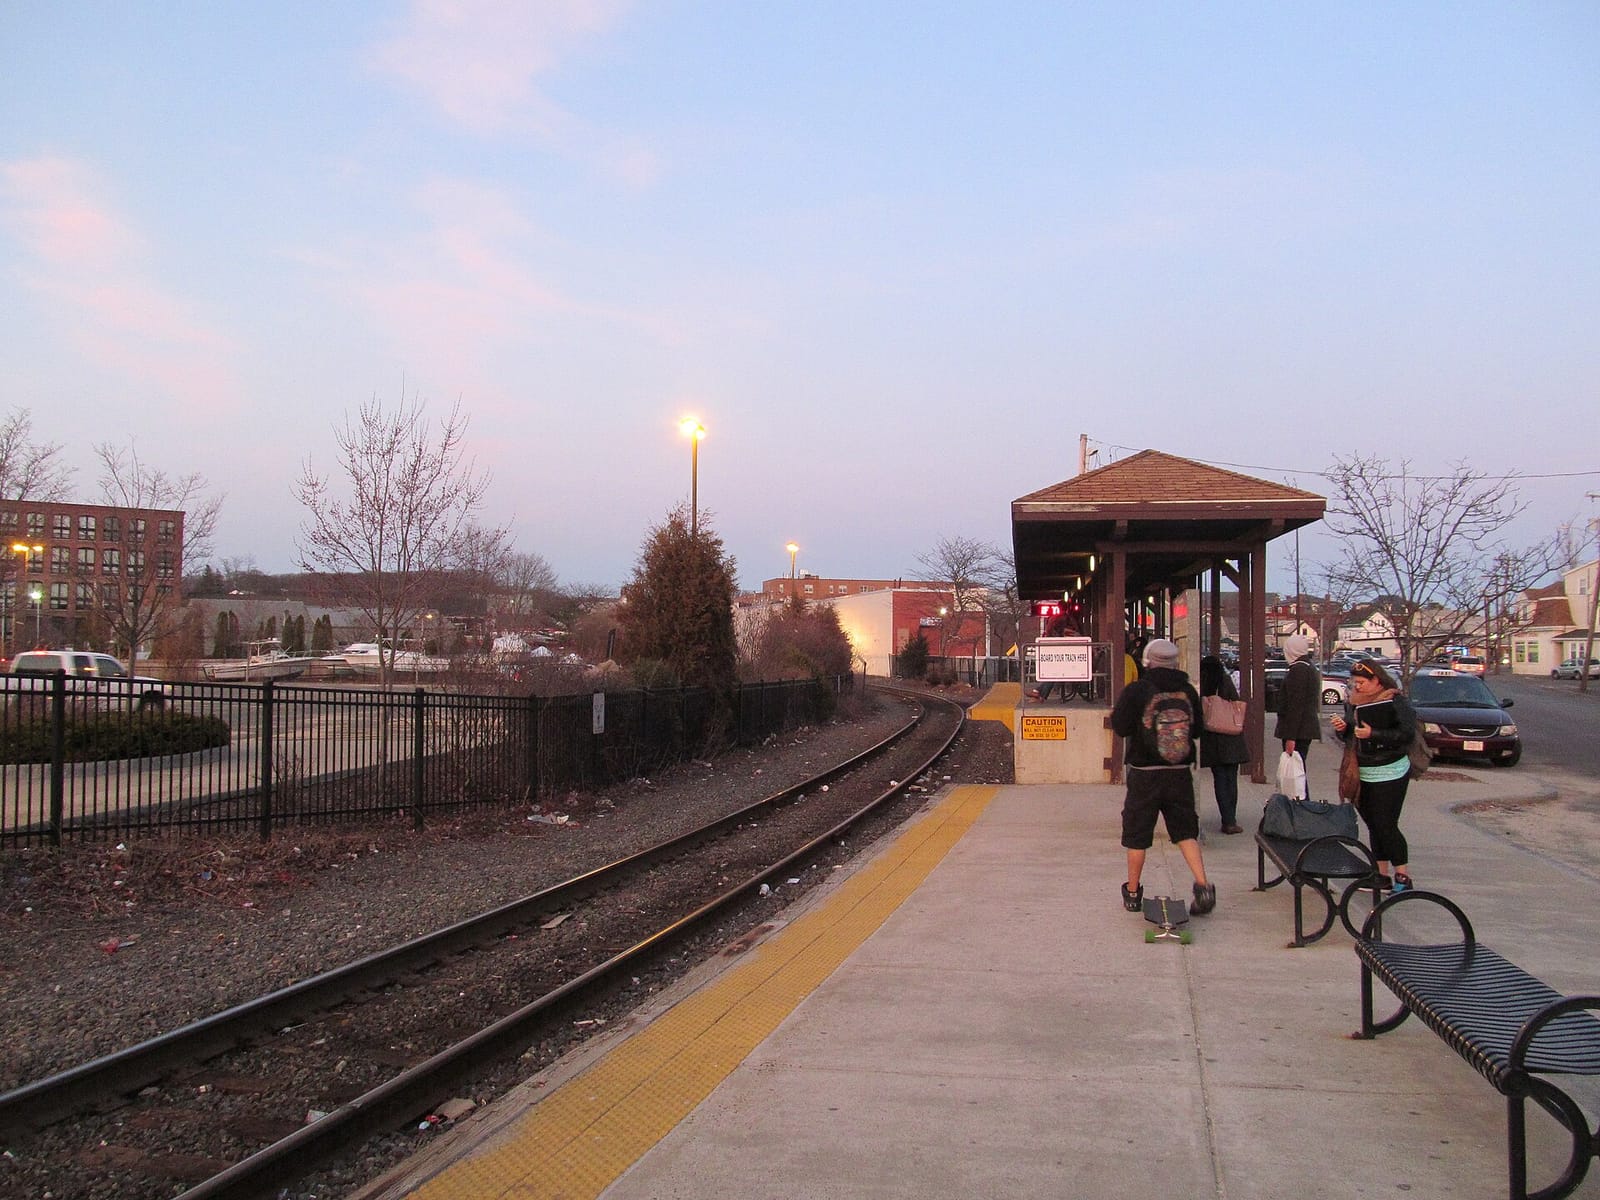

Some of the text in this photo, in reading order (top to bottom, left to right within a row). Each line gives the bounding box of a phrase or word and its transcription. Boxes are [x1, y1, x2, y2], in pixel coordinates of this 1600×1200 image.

[1041, 653, 1087, 662] BOARD YOUR TRAIN HERE
[1025, 718, 1063, 726] CAUTION
